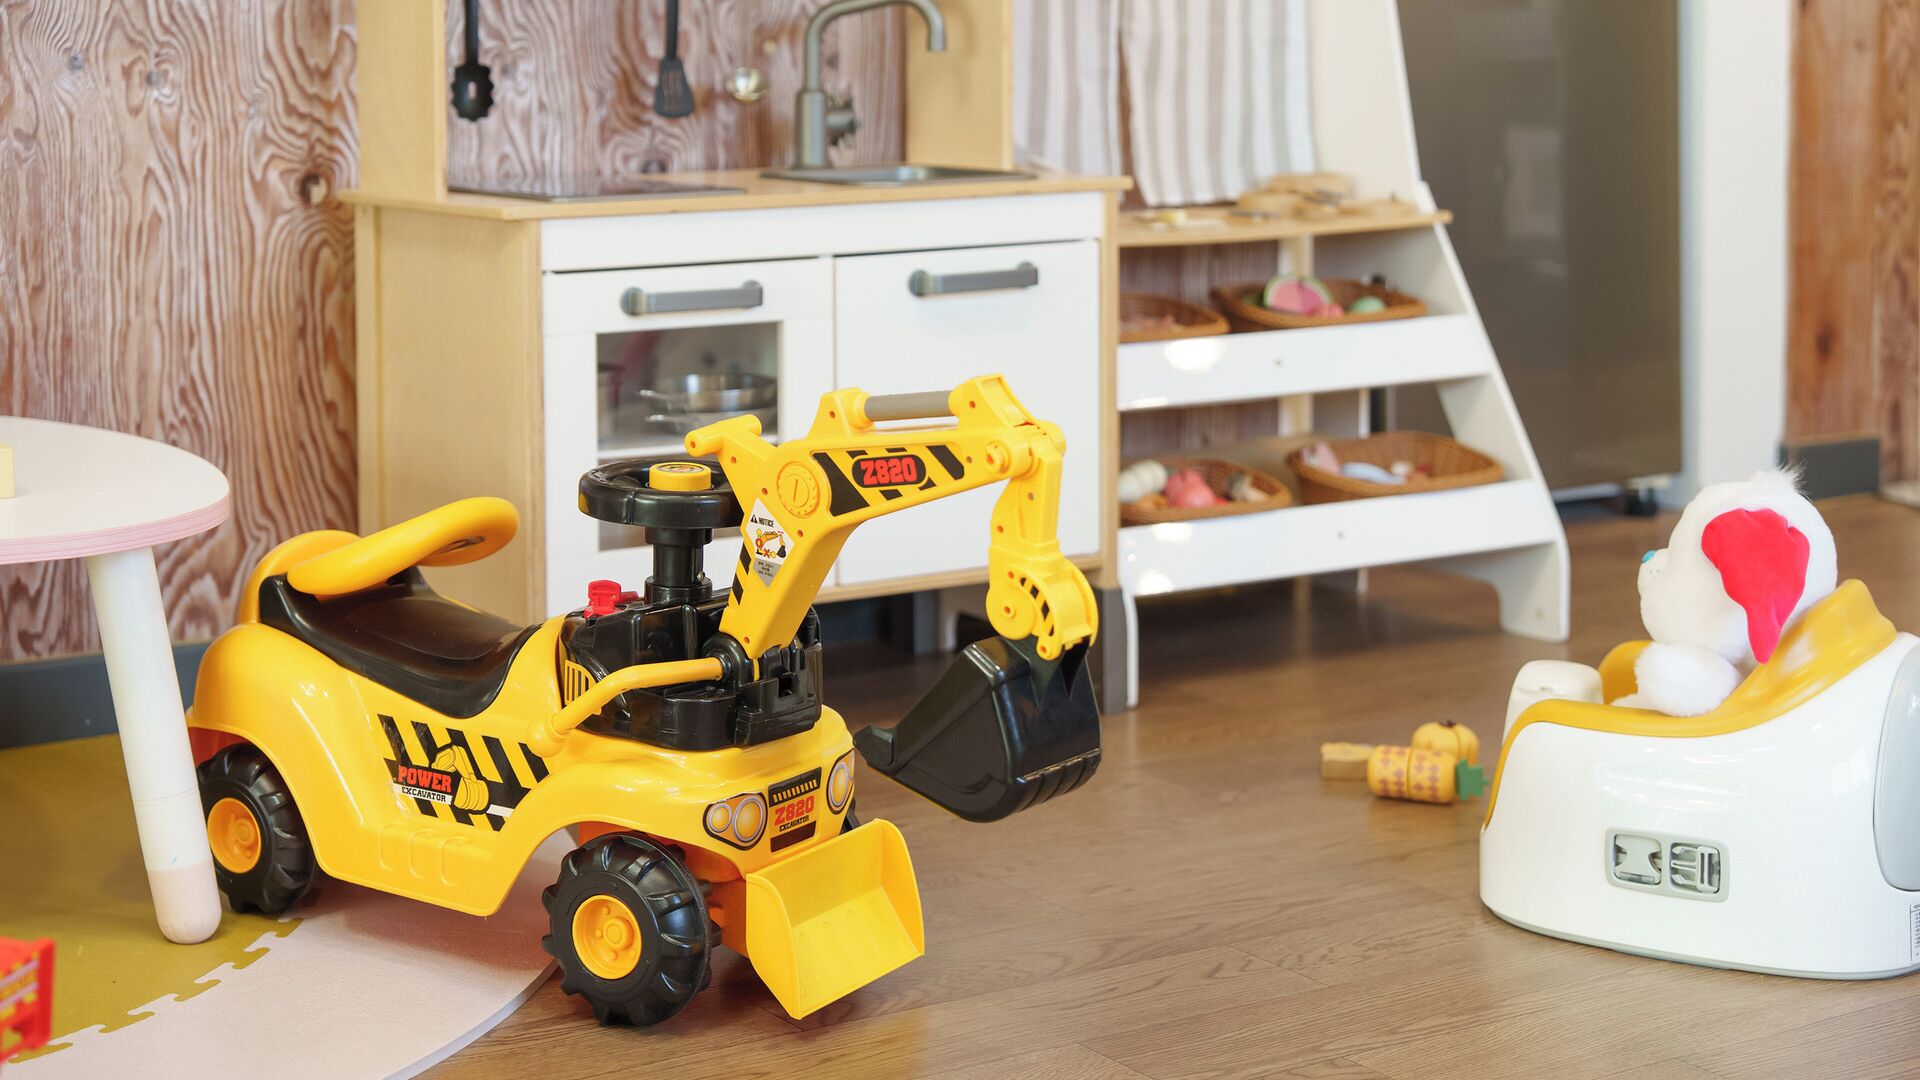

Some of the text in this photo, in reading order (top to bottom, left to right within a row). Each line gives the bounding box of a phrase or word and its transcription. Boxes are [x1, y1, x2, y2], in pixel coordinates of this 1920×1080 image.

[860, 457, 918, 485] Z820
[758, 517, 774, 528] NOTICE
[398, 765, 452, 793] POWER
[401, 787, 447, 803] EXCAVATOR
[774, 795, 815, 827] Z820
[779, 815, 810, 832] EXCAVATOR
